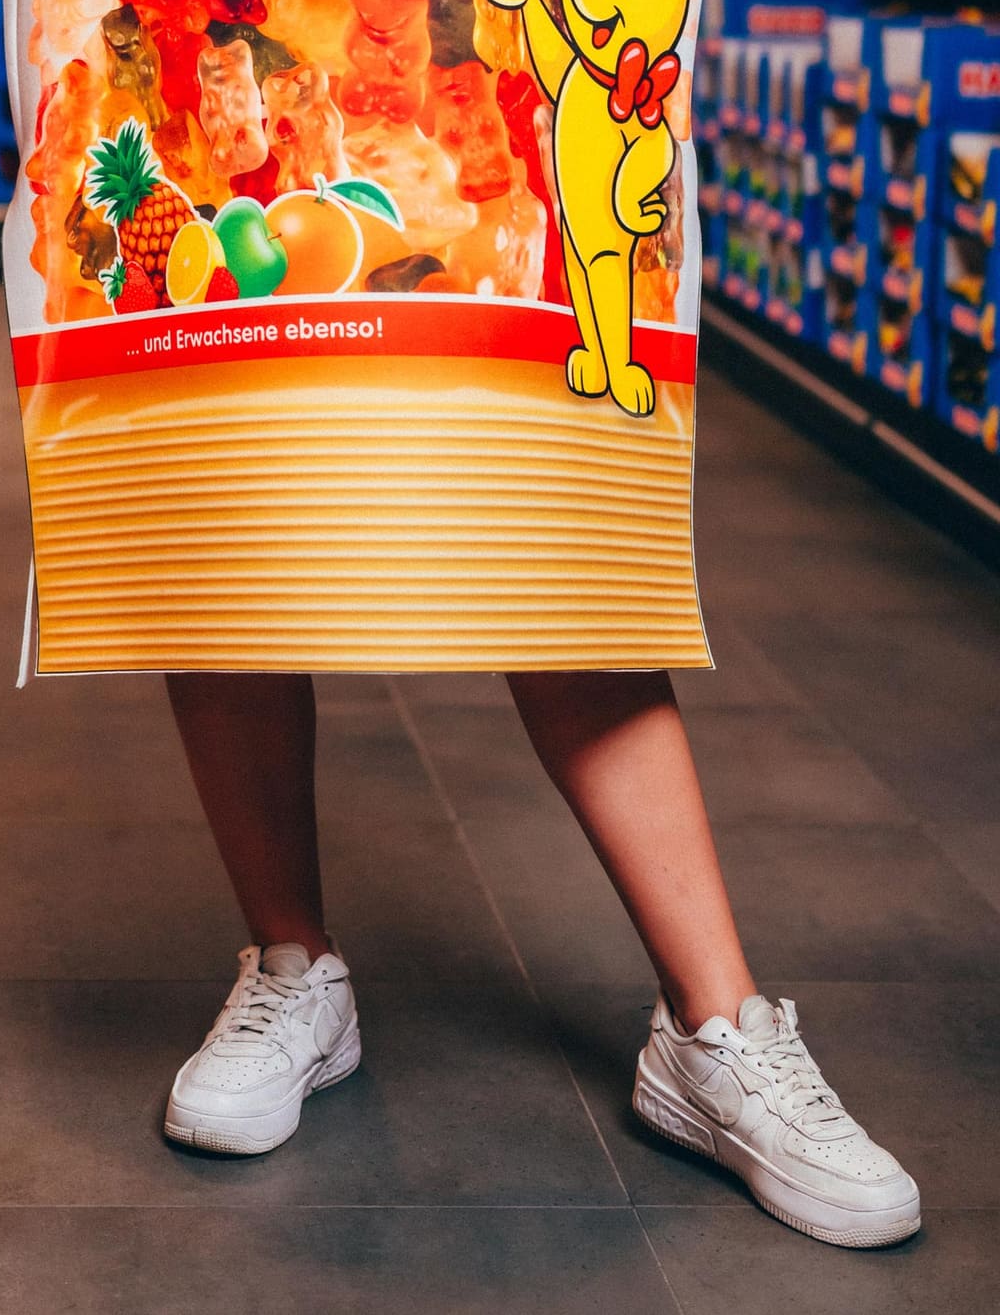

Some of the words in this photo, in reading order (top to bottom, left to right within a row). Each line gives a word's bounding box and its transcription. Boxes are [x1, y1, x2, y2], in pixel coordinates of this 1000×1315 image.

[144, 330, 172, 354] und
[176, 324, 279, 349] Erwachsene
[284, 316, 384, 340] ebenso!
